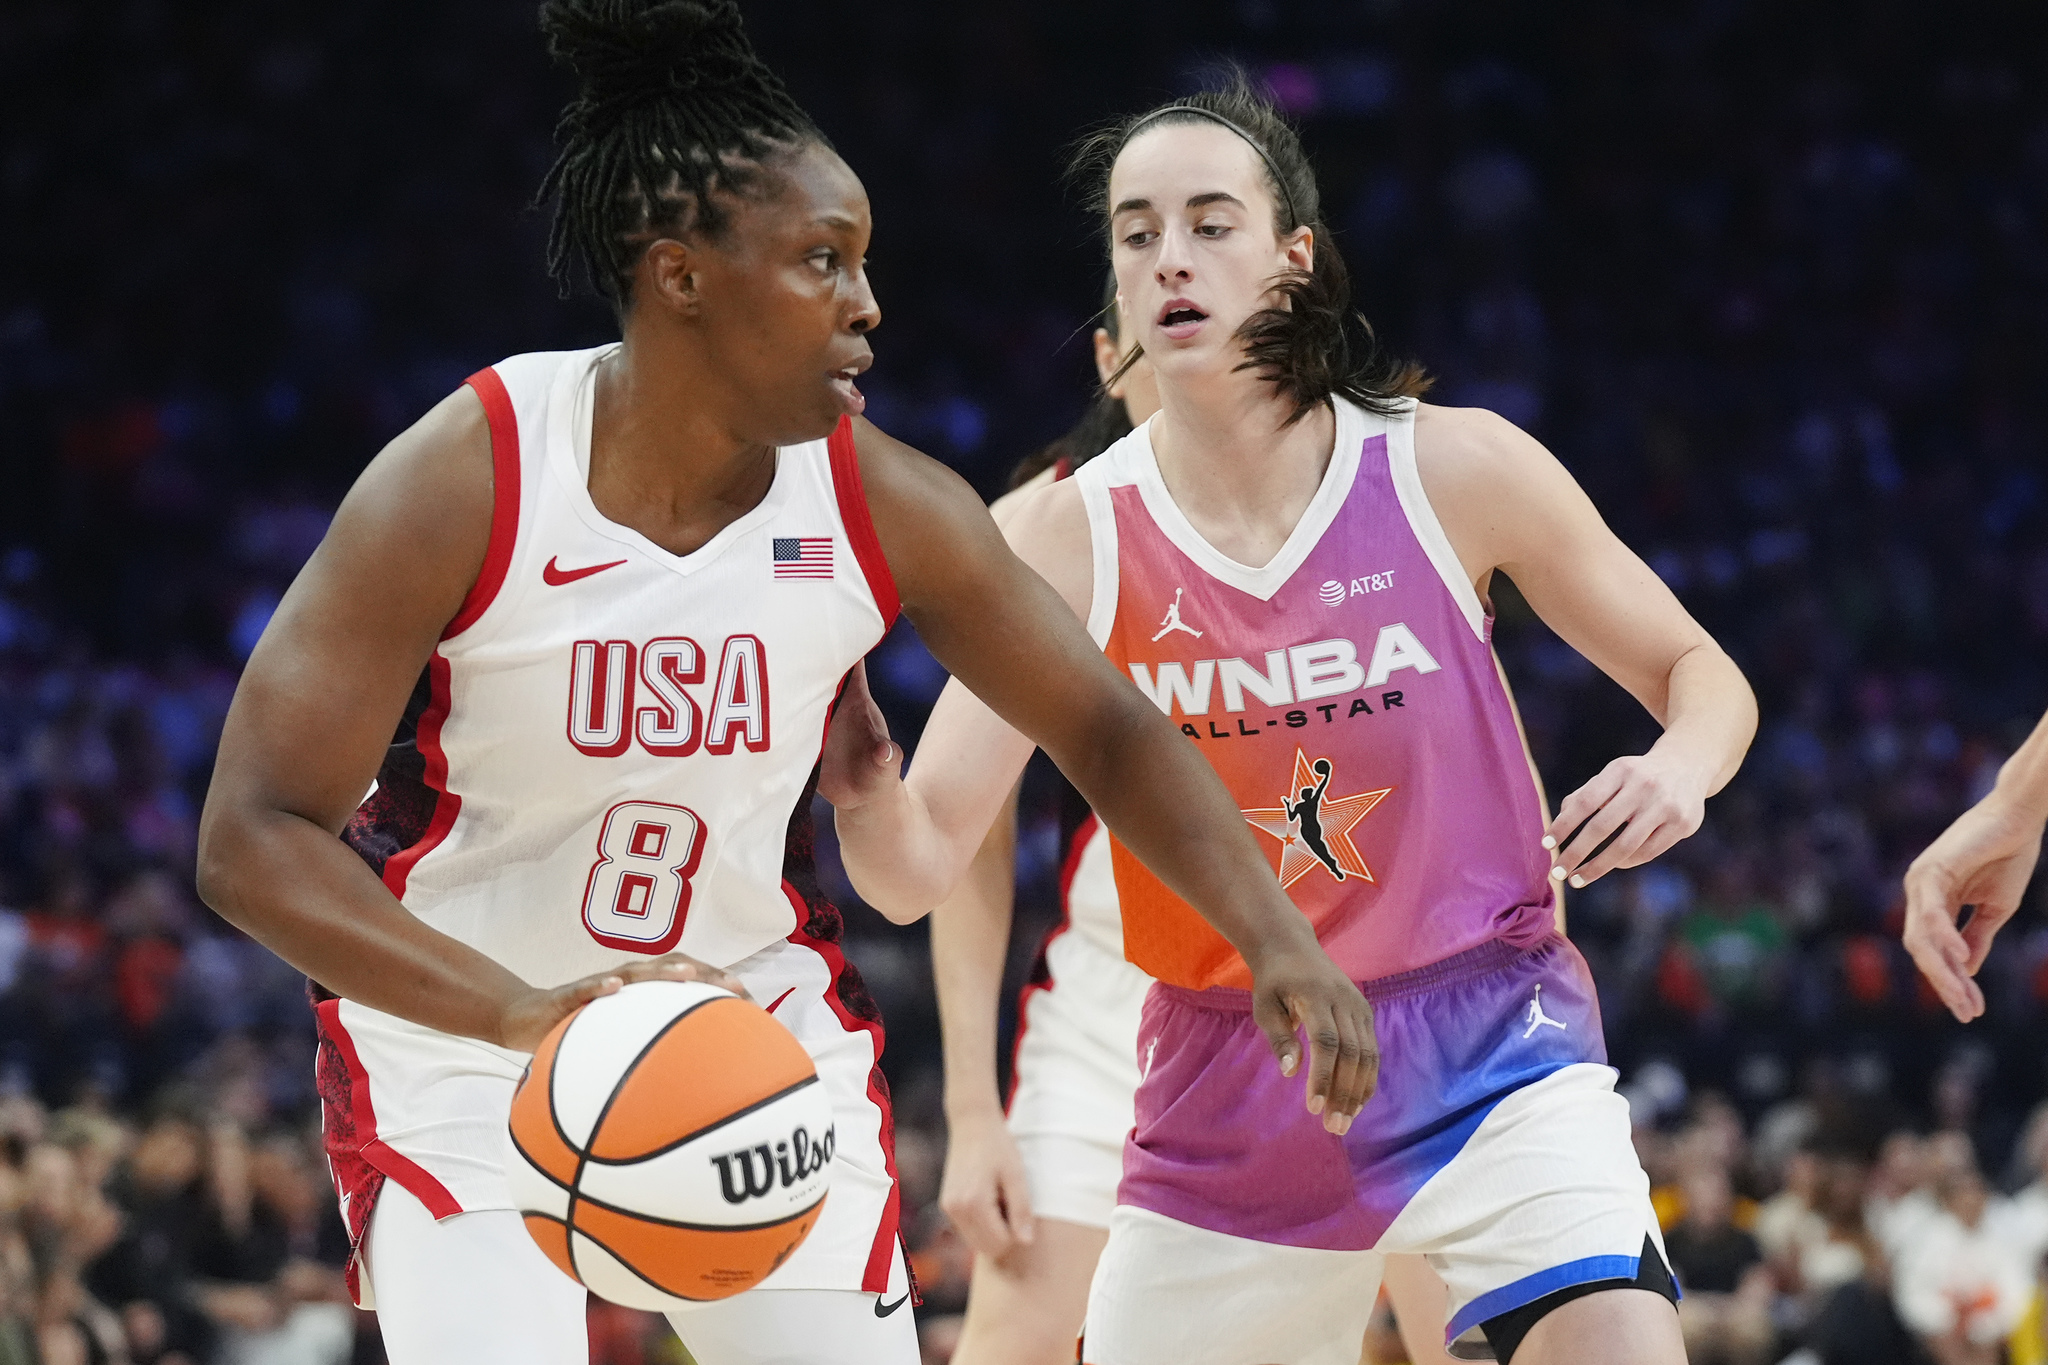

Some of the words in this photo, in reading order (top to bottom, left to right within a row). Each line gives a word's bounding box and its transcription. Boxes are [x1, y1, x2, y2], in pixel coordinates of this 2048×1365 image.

[1350, 570, 1395, 597] AT&T
[567, 634, 770, 758] USA
[1128, 622, 1442, 716] WNBA
[1181, 690, 1405, 739] ALL-STAR
[581, 800, 707, 955] 8
[711, 1121, 835, 1205] Wilso
